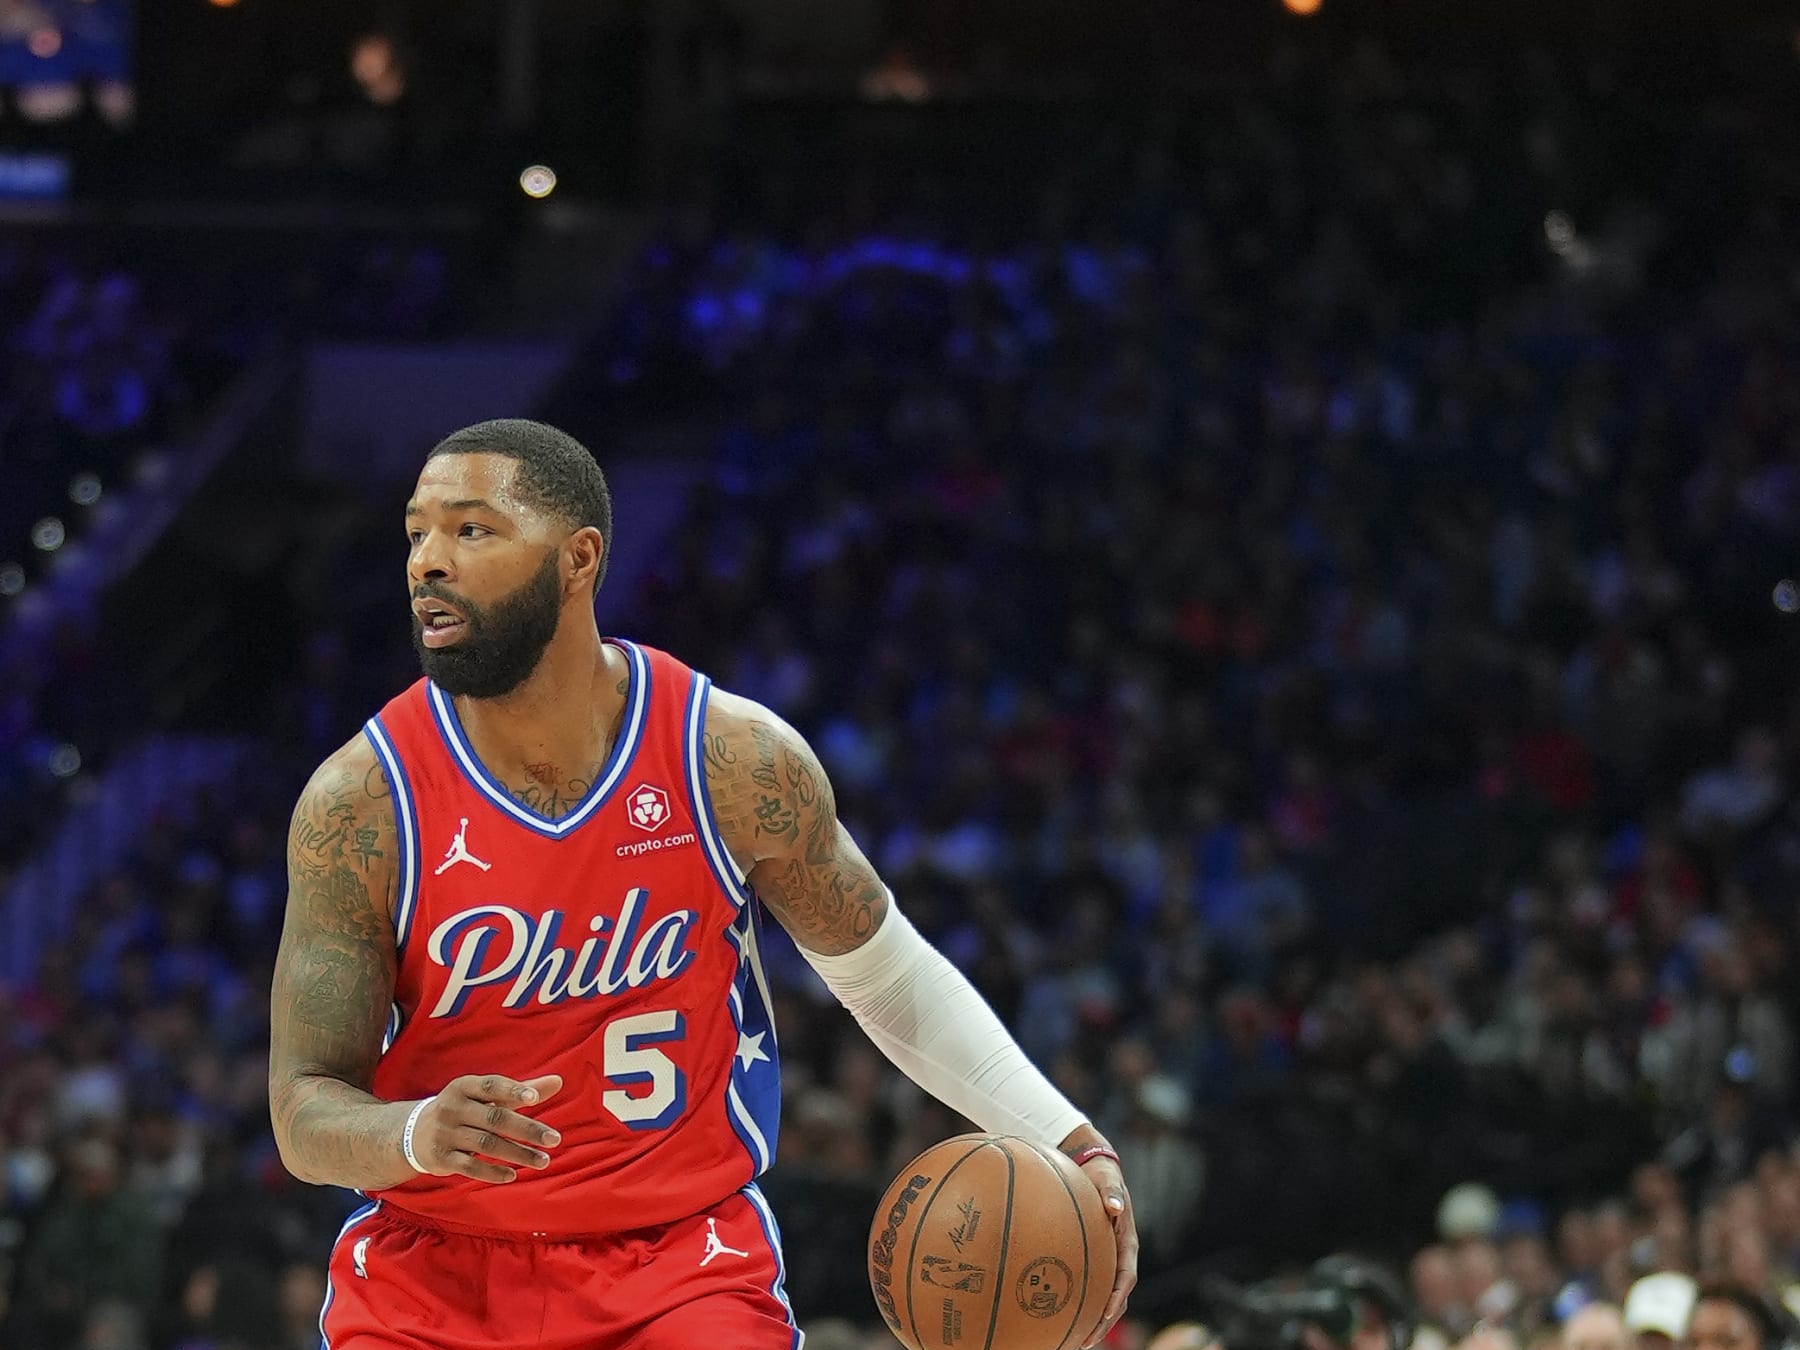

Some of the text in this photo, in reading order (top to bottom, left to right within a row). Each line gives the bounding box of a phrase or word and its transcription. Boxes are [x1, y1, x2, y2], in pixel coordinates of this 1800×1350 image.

[616, 833, 695, 857] crypto.com
[427, 888, 698, 1018] Phila
[603, 1010, 687, 1131] 5
